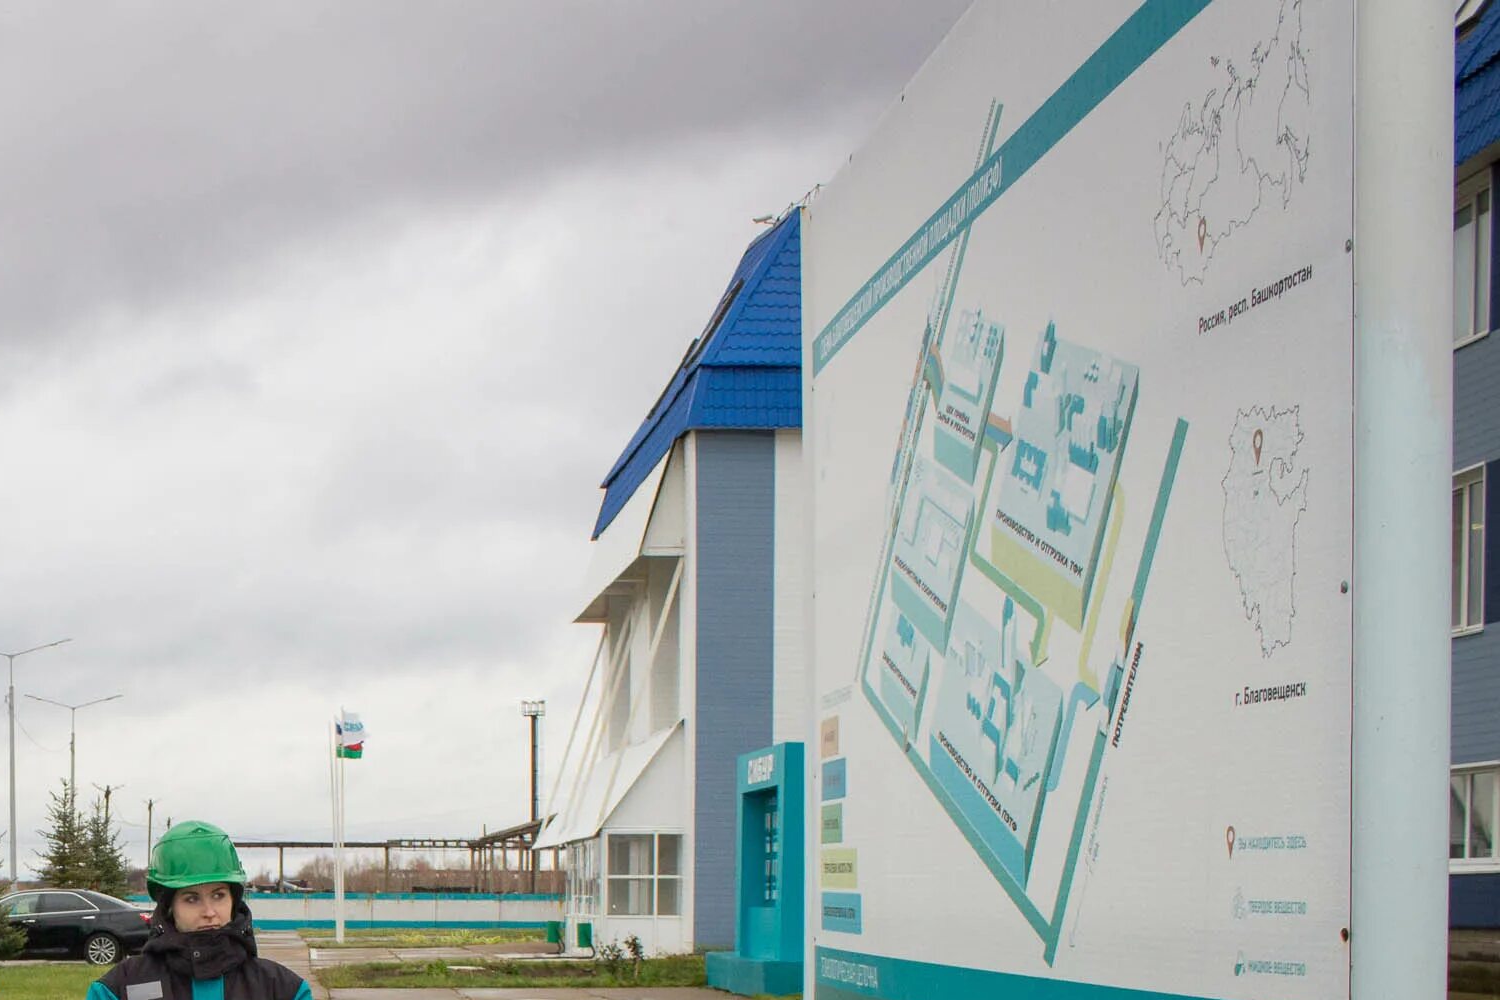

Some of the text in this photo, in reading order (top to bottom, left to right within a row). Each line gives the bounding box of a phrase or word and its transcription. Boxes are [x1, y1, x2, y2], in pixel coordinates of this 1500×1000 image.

[1198, 264, 1312, 336] Россия, респ. Башкортостан
[996, 509, 1034, 544] ПРОИЗВОДСТВО
[1040, 541, 1068, 568] ОТГРУЗКА
[1069, 560, 1083, 577] ТФК
[1112, 641, 1144, 748] ПОТРЕБИТЕЛЯМ
[1235, 682, 1306, 706] г. Благовещенск
[938, 731, 972, 777] ПРОИЗВОДСТВО
[977, 779, 1001, 813] ОТГРУЗКА
[1001, 804, 1017, 832] ПЭТФ
